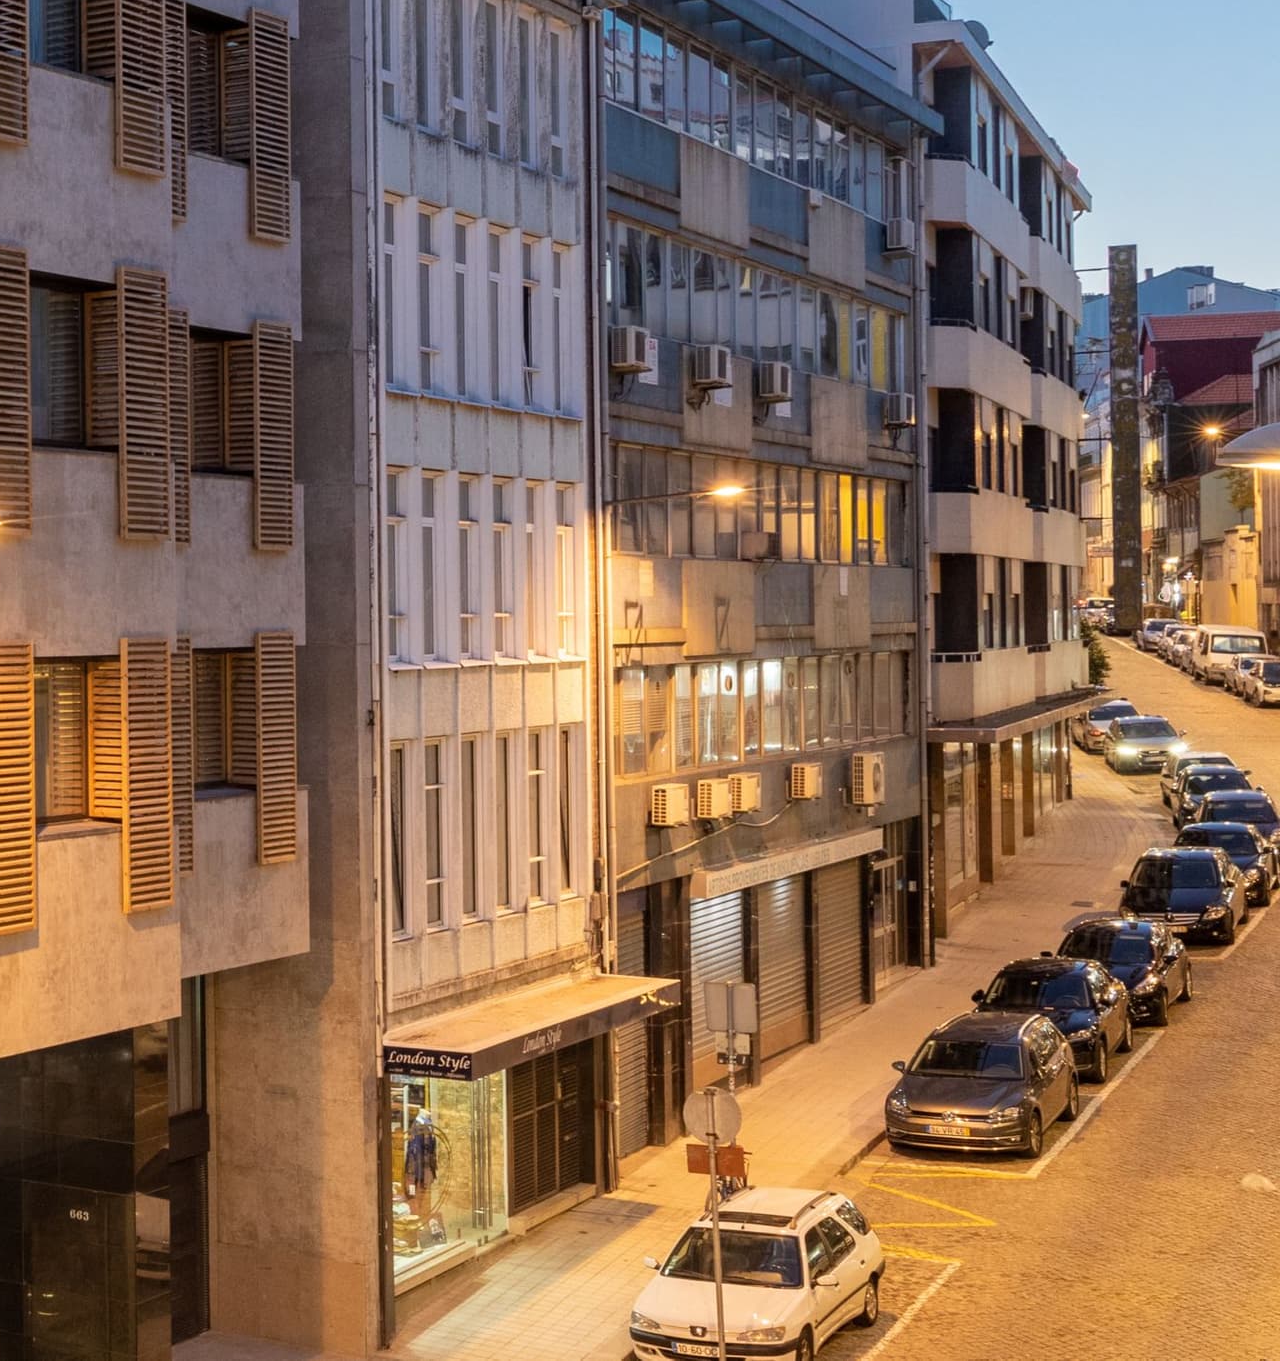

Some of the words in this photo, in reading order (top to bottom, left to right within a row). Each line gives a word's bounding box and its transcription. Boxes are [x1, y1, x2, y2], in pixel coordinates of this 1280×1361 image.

[387, 1050, 435, 1066] London
[438, 1054, 471, 1072] Style
[69, 1208, 89, 1221] 663
